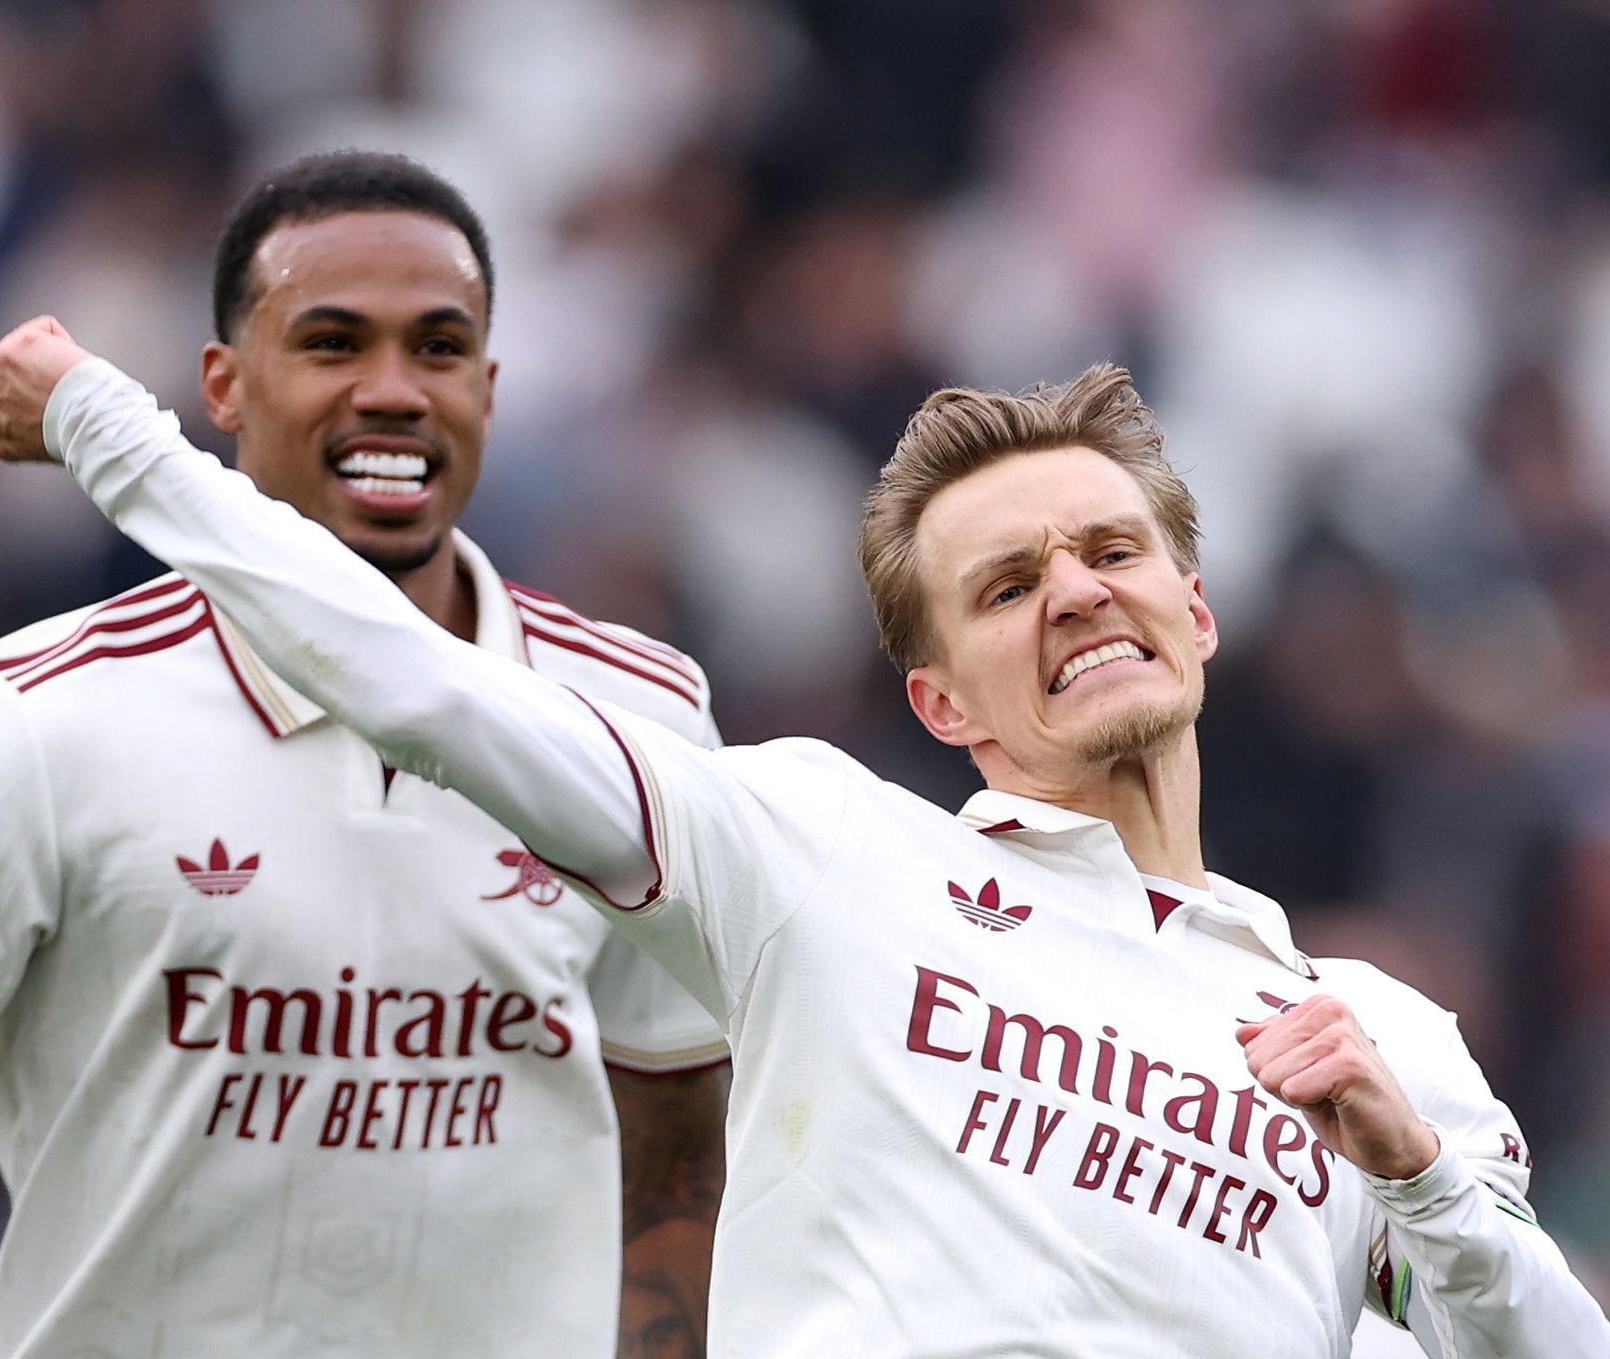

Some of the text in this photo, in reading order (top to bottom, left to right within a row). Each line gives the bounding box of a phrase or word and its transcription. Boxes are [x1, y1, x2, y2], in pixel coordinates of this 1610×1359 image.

[161, 966, 573, 1058] Emirates
[203, 1072, 503, 1150] FLY BETTER
[905, 964, 1335, 1208] Emirates
[956, 1090, 1278, 1259] FLY BETTER
